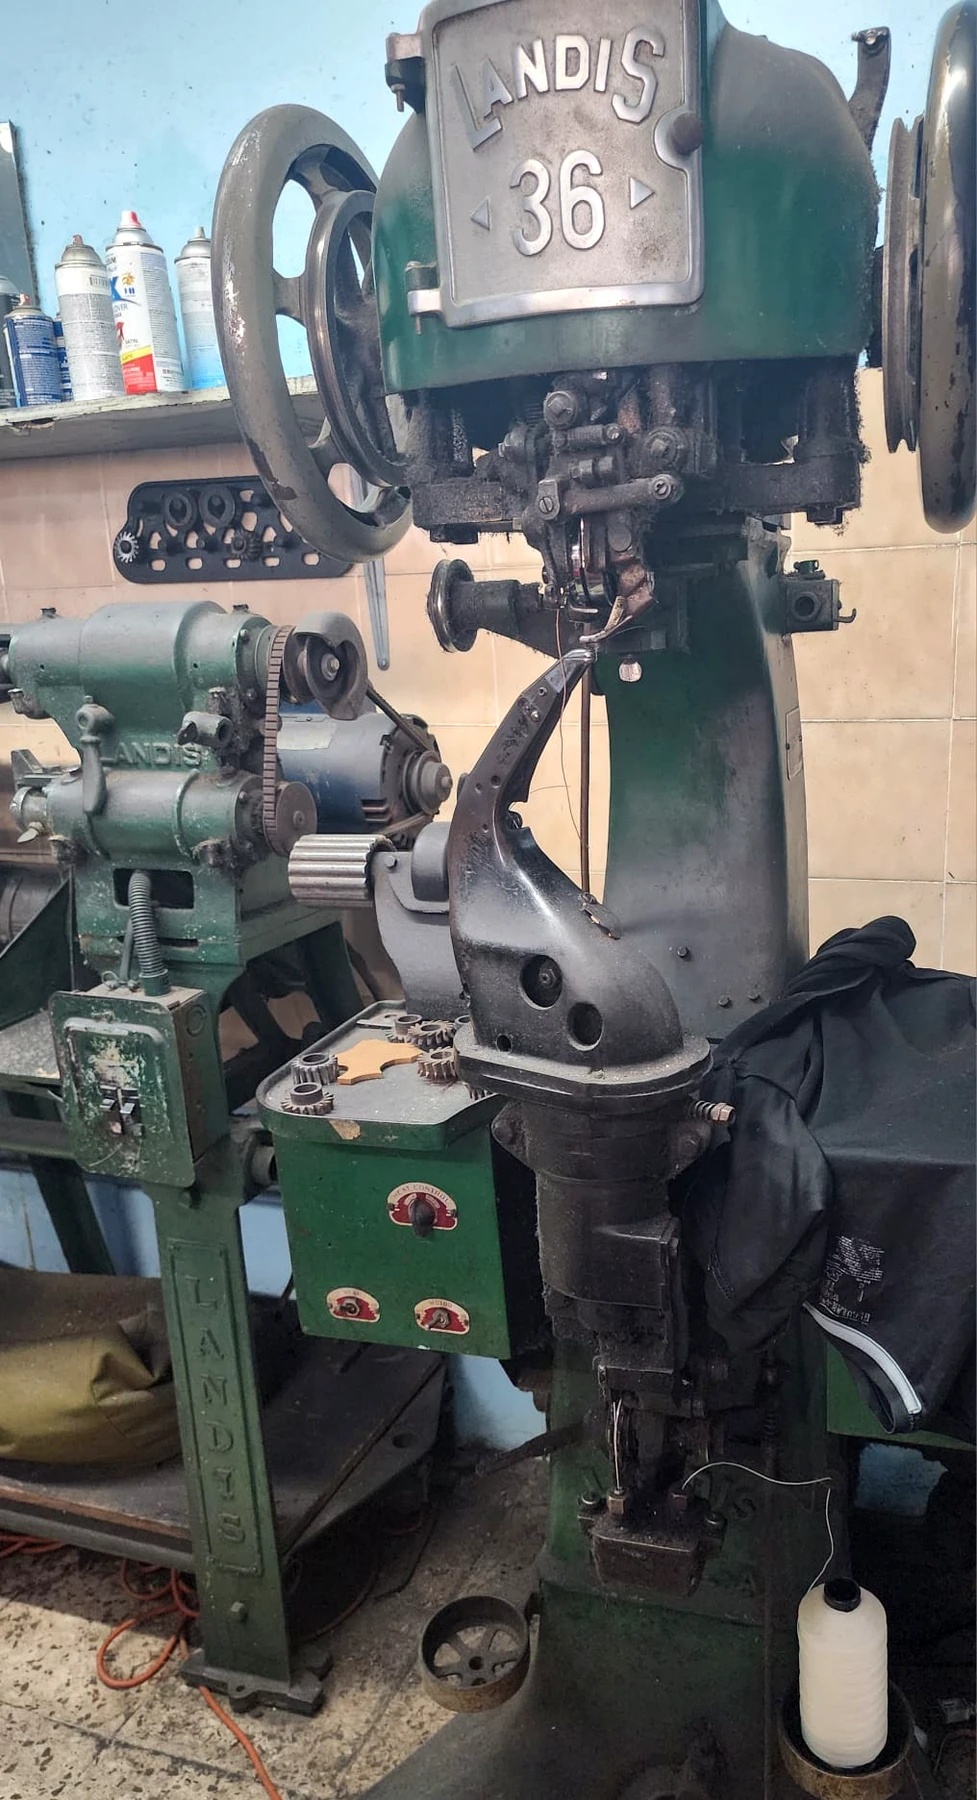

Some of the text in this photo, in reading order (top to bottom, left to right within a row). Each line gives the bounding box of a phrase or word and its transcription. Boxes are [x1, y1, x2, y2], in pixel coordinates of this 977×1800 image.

[453, 24, 666, 152] LANDIS
[510, 149, 606, 256] 36
[184, 1275, 246, 1544] LANDIS
